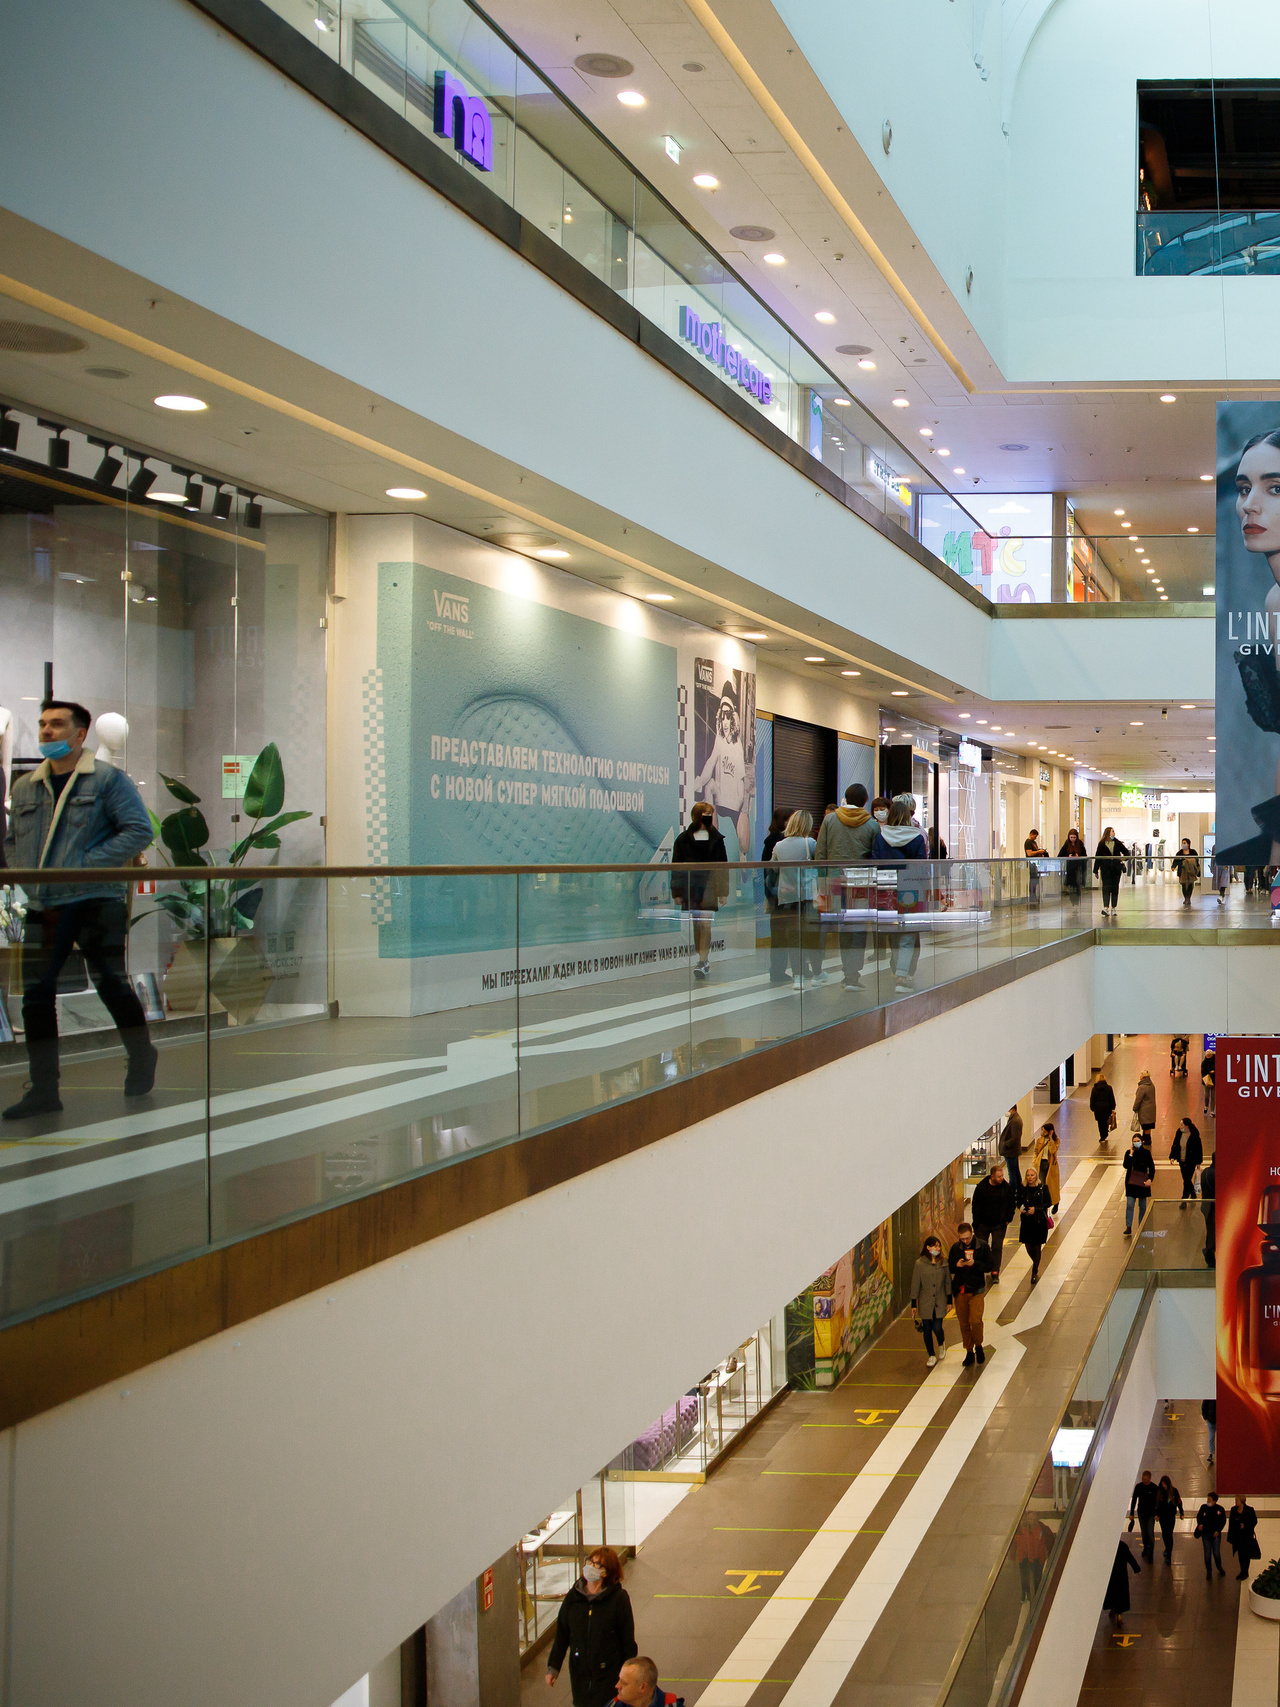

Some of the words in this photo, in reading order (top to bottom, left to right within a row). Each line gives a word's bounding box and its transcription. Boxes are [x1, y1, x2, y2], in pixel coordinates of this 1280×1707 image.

[679, 305, 772, 405] mothercare
[433, 588, 470, 624] VANS
[443, 624, 455, 636] THE
[697, 664, 713, 683] VANS
[430, 735, 538, 771] ПРЕДСТАВЛЯЕМ
[542, 750, 614, 780] ТЕХНОЛОГИЮ
[616, 760, 670, 785] COMFYCUSH
[430, 773, 441, 799] С
[445, 774, 493, 803] НОВОЙ
[497, 780, 538, 805] СУПЕР
[541, 783, 586, 809] МЯГКОЙ
[589, 788, 645, 813] ПОДОШВОЙ
[1121, 788, 1143, 808] sela
[482, 973, 498, 990] МЫ
[553, 961, 576, 980] ЖДЕМ
[577, 959, 592, 975] ВАС
[594, 958, 599, 973] В
[600, 955, 624, 972] НОВОМ
[625, 949, 657, 966] МАГАЗИНЕ
[658, 947, 673, 961] VANS
[673, 946, 678, 959] В
